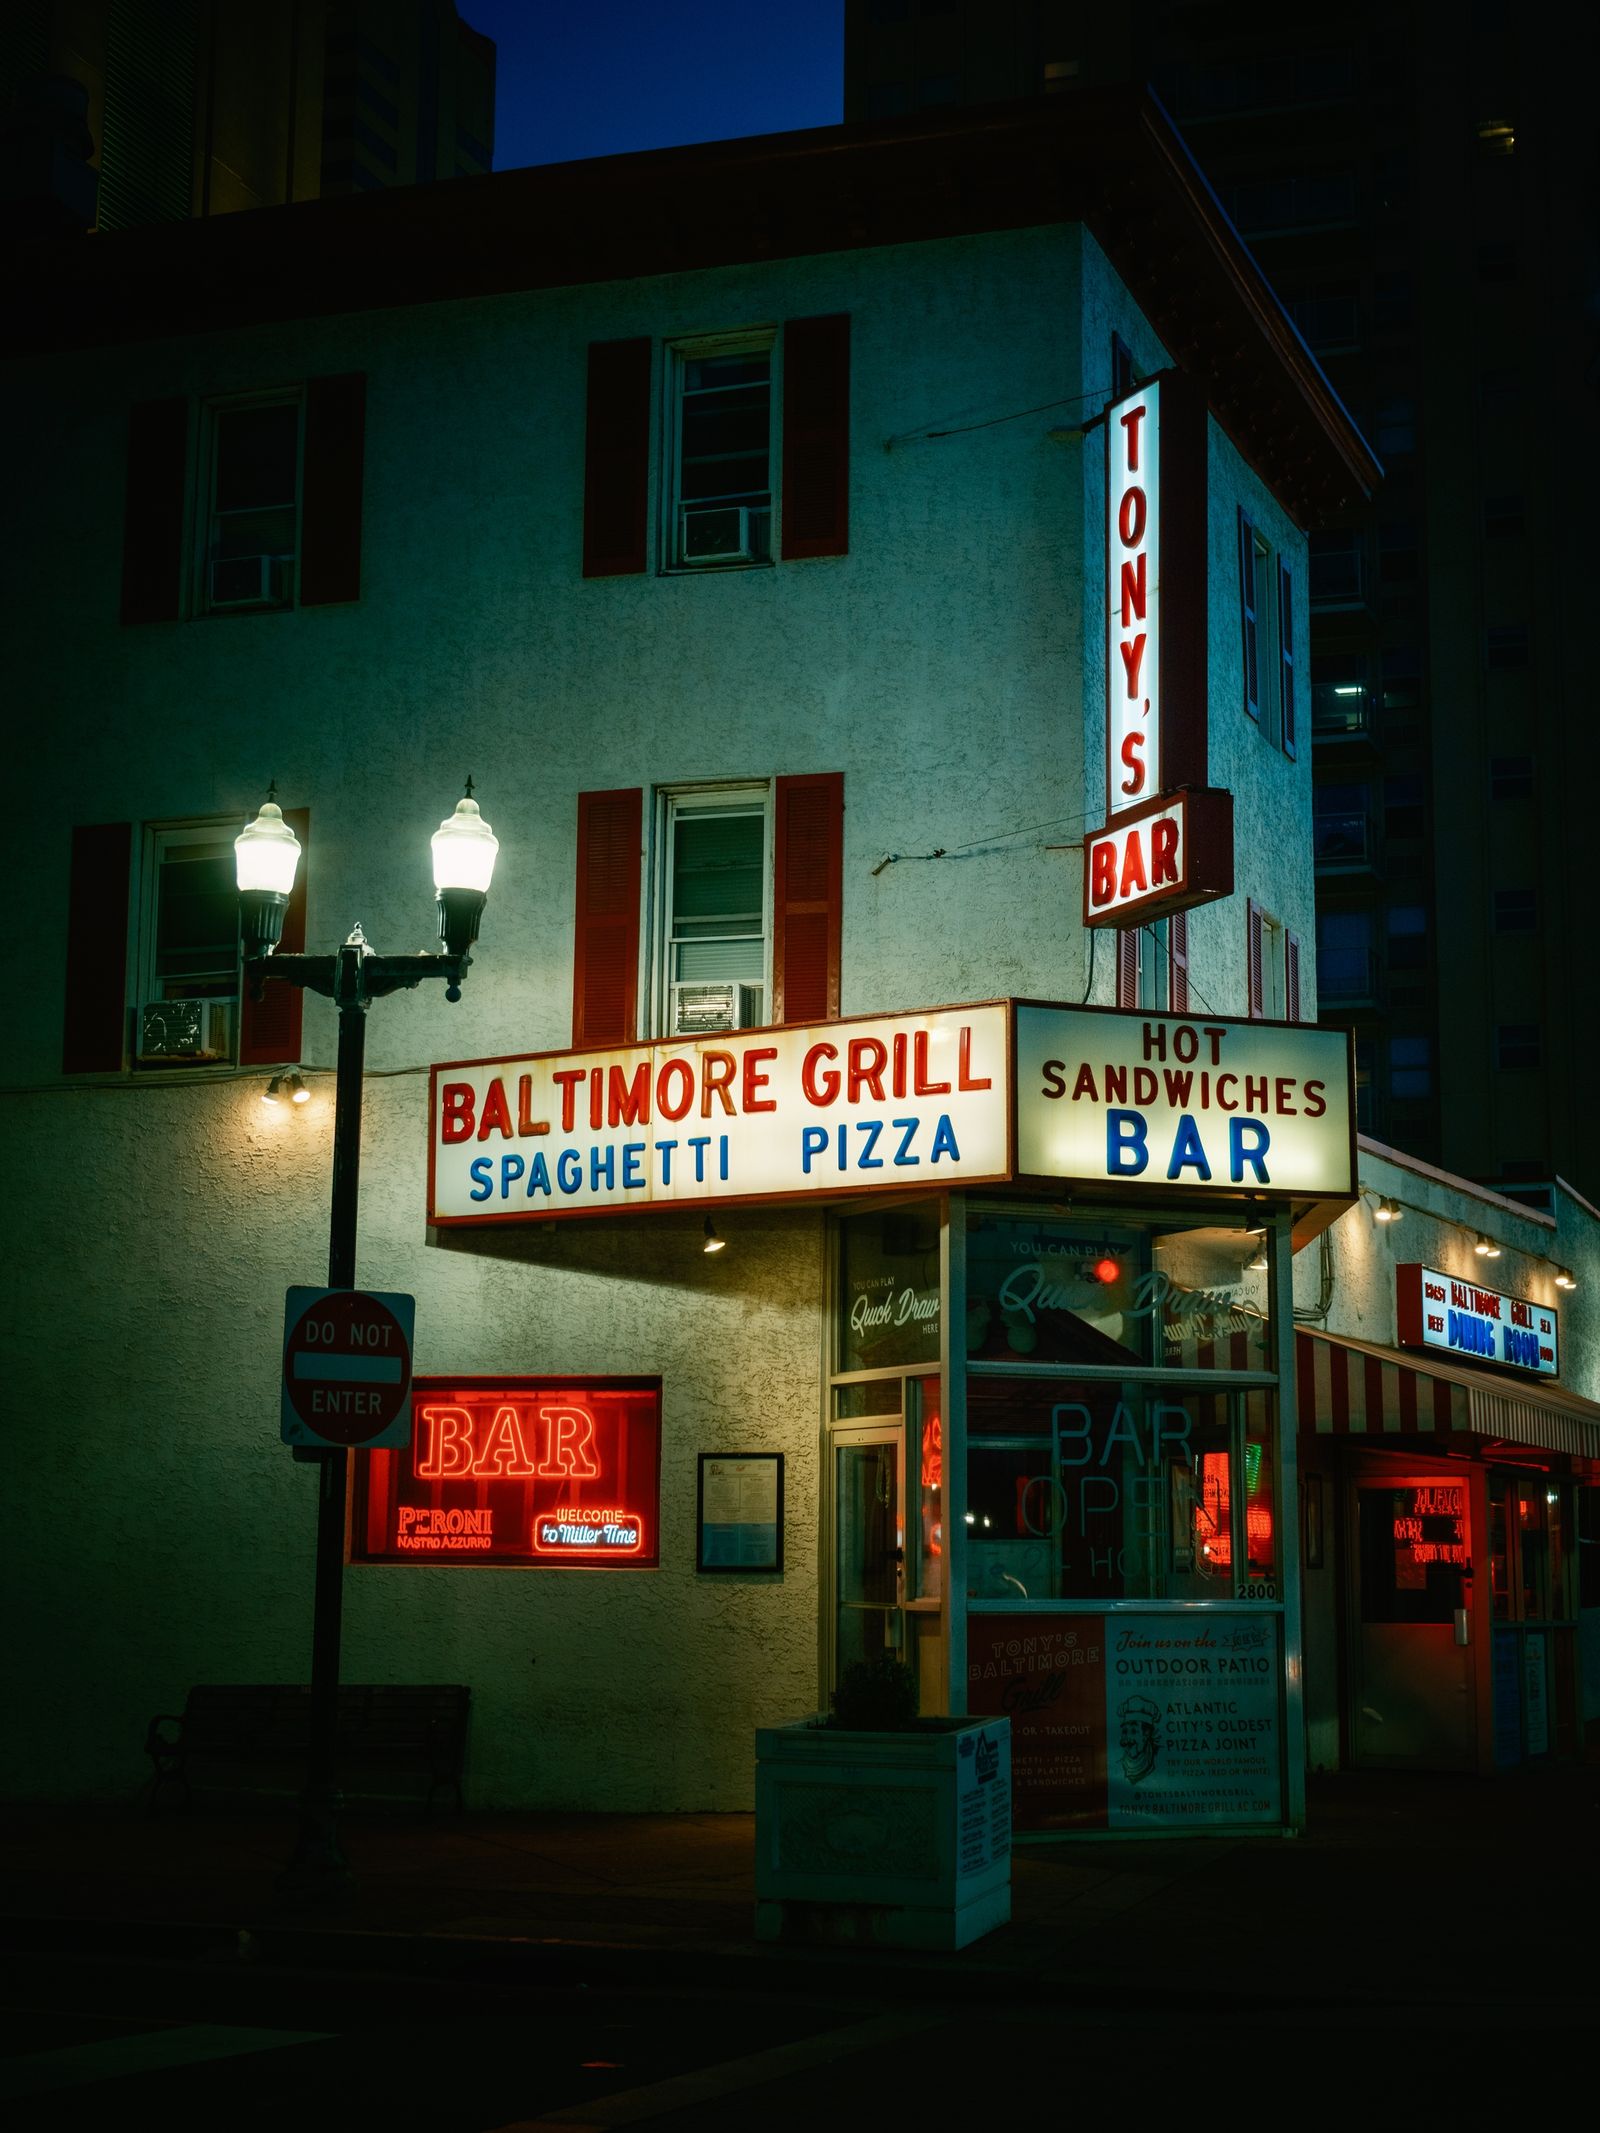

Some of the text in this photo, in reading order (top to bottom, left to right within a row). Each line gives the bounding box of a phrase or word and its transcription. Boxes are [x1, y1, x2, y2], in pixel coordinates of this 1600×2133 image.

[1091, 815, 1180, 908] BAR
[1142, 1022, 1227, 1066] HOT
[441, 1026, 993, 1145] BALTIMORE GRILL
[1041, 1059, 1328, 1118] SANDWICHES
[469, 1113, 961, 1202] SPAGHETTI PIZZA
[1106, 1107, 1271, 1185] BAR
[1009, 1240, 1122, 1261] YOU CAN PLAY
[852, 1275, 896, 1292] YOU CAN PLAY
[850, 1287, 941, 1338] Quick Draw
[1451, 1280, 1534, 1330] BALTIMORE GRILL
[304, 1320, 393, 1349] DO NOT
[922, 1323, 939, 1335] HERE
[1447, 1308, 1541, 1369] DINING ROOM
[311, 1389, 383, 1415] ENTER
[418, 1405, 597, 1478] BAR
[1051, 1400, 1194, 1468] BAR
[397, 1506, 494, 1536] PERONI
[556, 1508, 624, 1523] WELCOME
[541, 1523, 637, 1544] to Miller Time
[1237, 1584, 1276, 1600] 2800
[991, 1631, 1079, 1659] TONY'S
[1116, 1630, 1151, 1653] Join
[1154, 1638, 1171, 1648] us
[1174, 1638, 1192, 1648] on
[1193, 1628, 1217, 1648] the
[968, 1647, 1101, 1681] BALTIMORE
[1115, 1657, 1270, 1675] OUTDOOR PATIO
[1001, 1671, 1068, 1713] Grill
[1166, 1702, 1238, 1716] ATLANTIC
[1022, 1724, 1091, 1737] OR TAKEOUT
[1166, 1718, 1273, 1735] CITY'S OLDEST
[1166, 1736, 1257, 1752] PIZZA JOINT
[1036, 1766, 1084, 1777] PLATTERS
[1054, 1755, 1081, 1765] PIZZA
[1182, 1768, 1205, 1778] PIZZA
[1229, 1767, 1241, 1777] OR
[1184, 1758, 1201, 1767] OUR
[1234, 1756, 1266, 1765] FAMOUS
[1027, 1777, 1087, 1787] SANDWICHES
